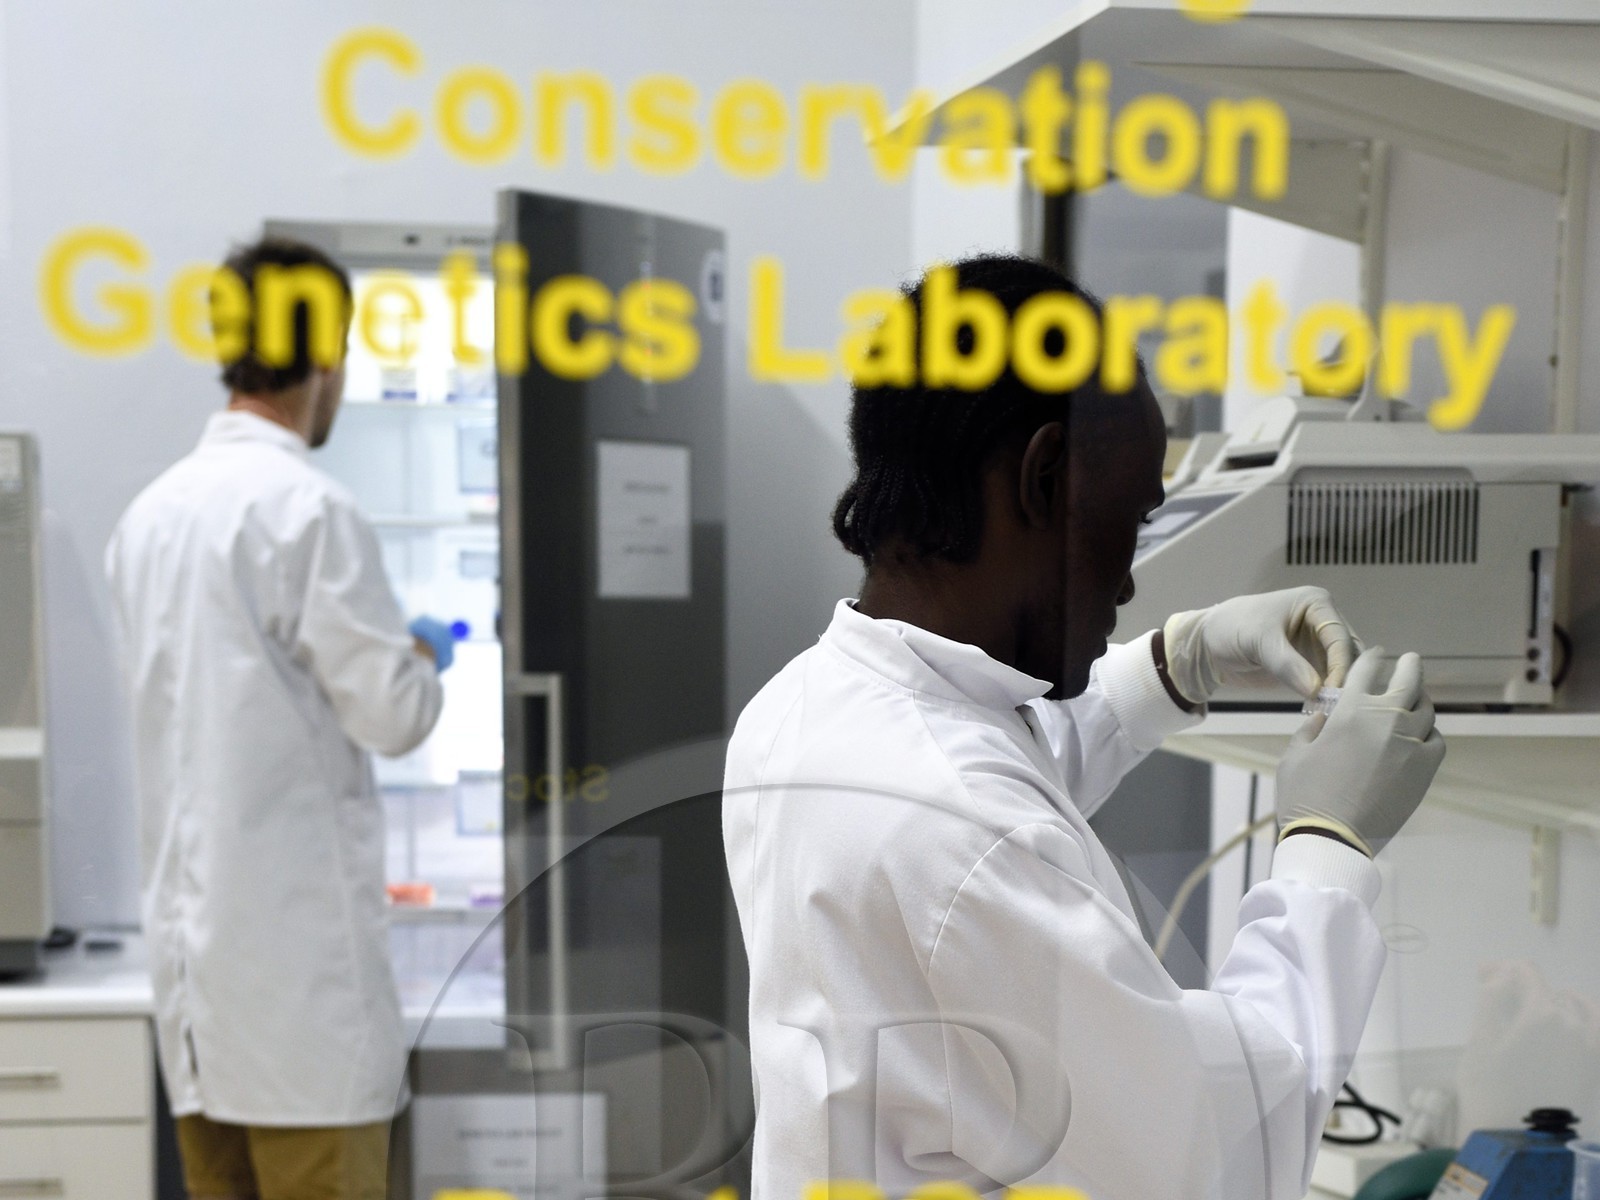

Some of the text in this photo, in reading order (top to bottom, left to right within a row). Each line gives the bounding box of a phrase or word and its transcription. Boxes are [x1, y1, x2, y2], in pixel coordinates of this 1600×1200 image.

[320, 27, 1291, 200] Conservation
[40, 228, 1514, 430] Genetics Laboratory
